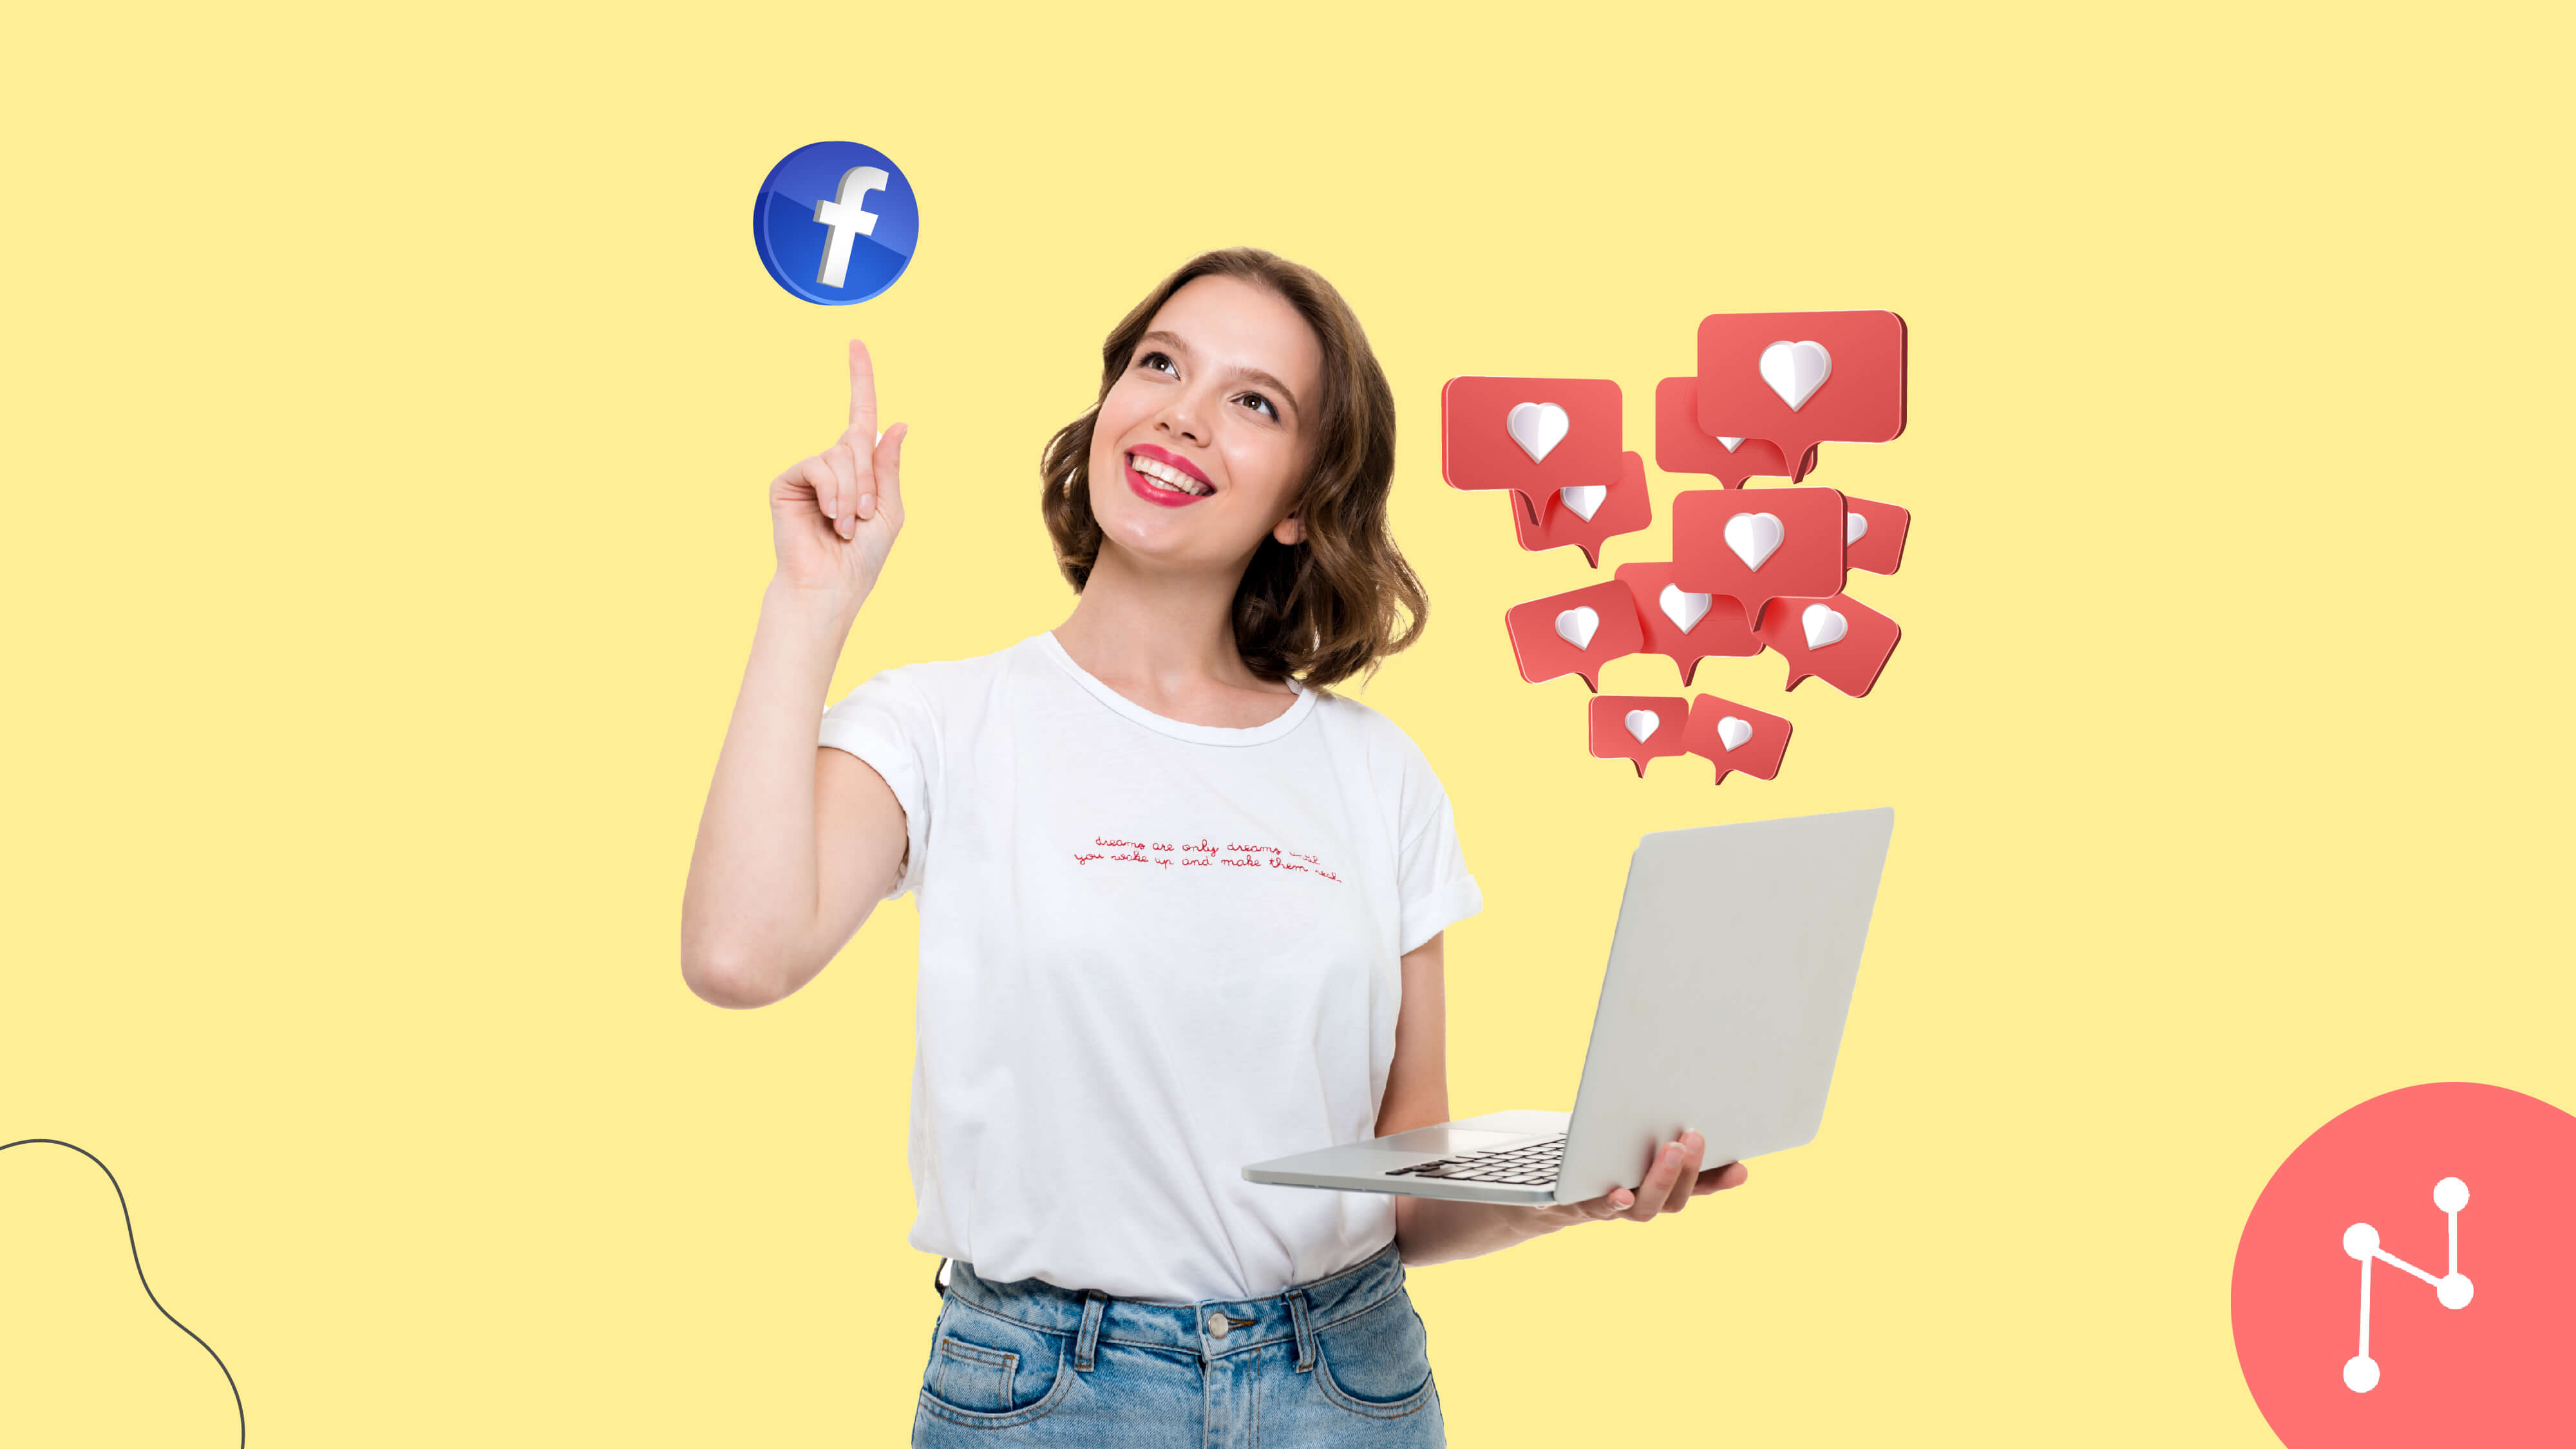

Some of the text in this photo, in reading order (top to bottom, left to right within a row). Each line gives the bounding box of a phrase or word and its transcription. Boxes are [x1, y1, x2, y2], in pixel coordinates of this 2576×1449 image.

[1095, 835, 1146, 850] dreams
[1152, 842, 1175, 852] are
[1182, 838, 1220, 858] only
[1226, 841, 1282, 856] dreams
[1074, 853, 1104, 866] you
[1110, 850, 1150, 863] wake
[1155, 857, 1175, 871] up
[1181, 855, 1213, 866] and
[1220, 854, 1262, 867] make
[1269, 857, 1309, 873] them
